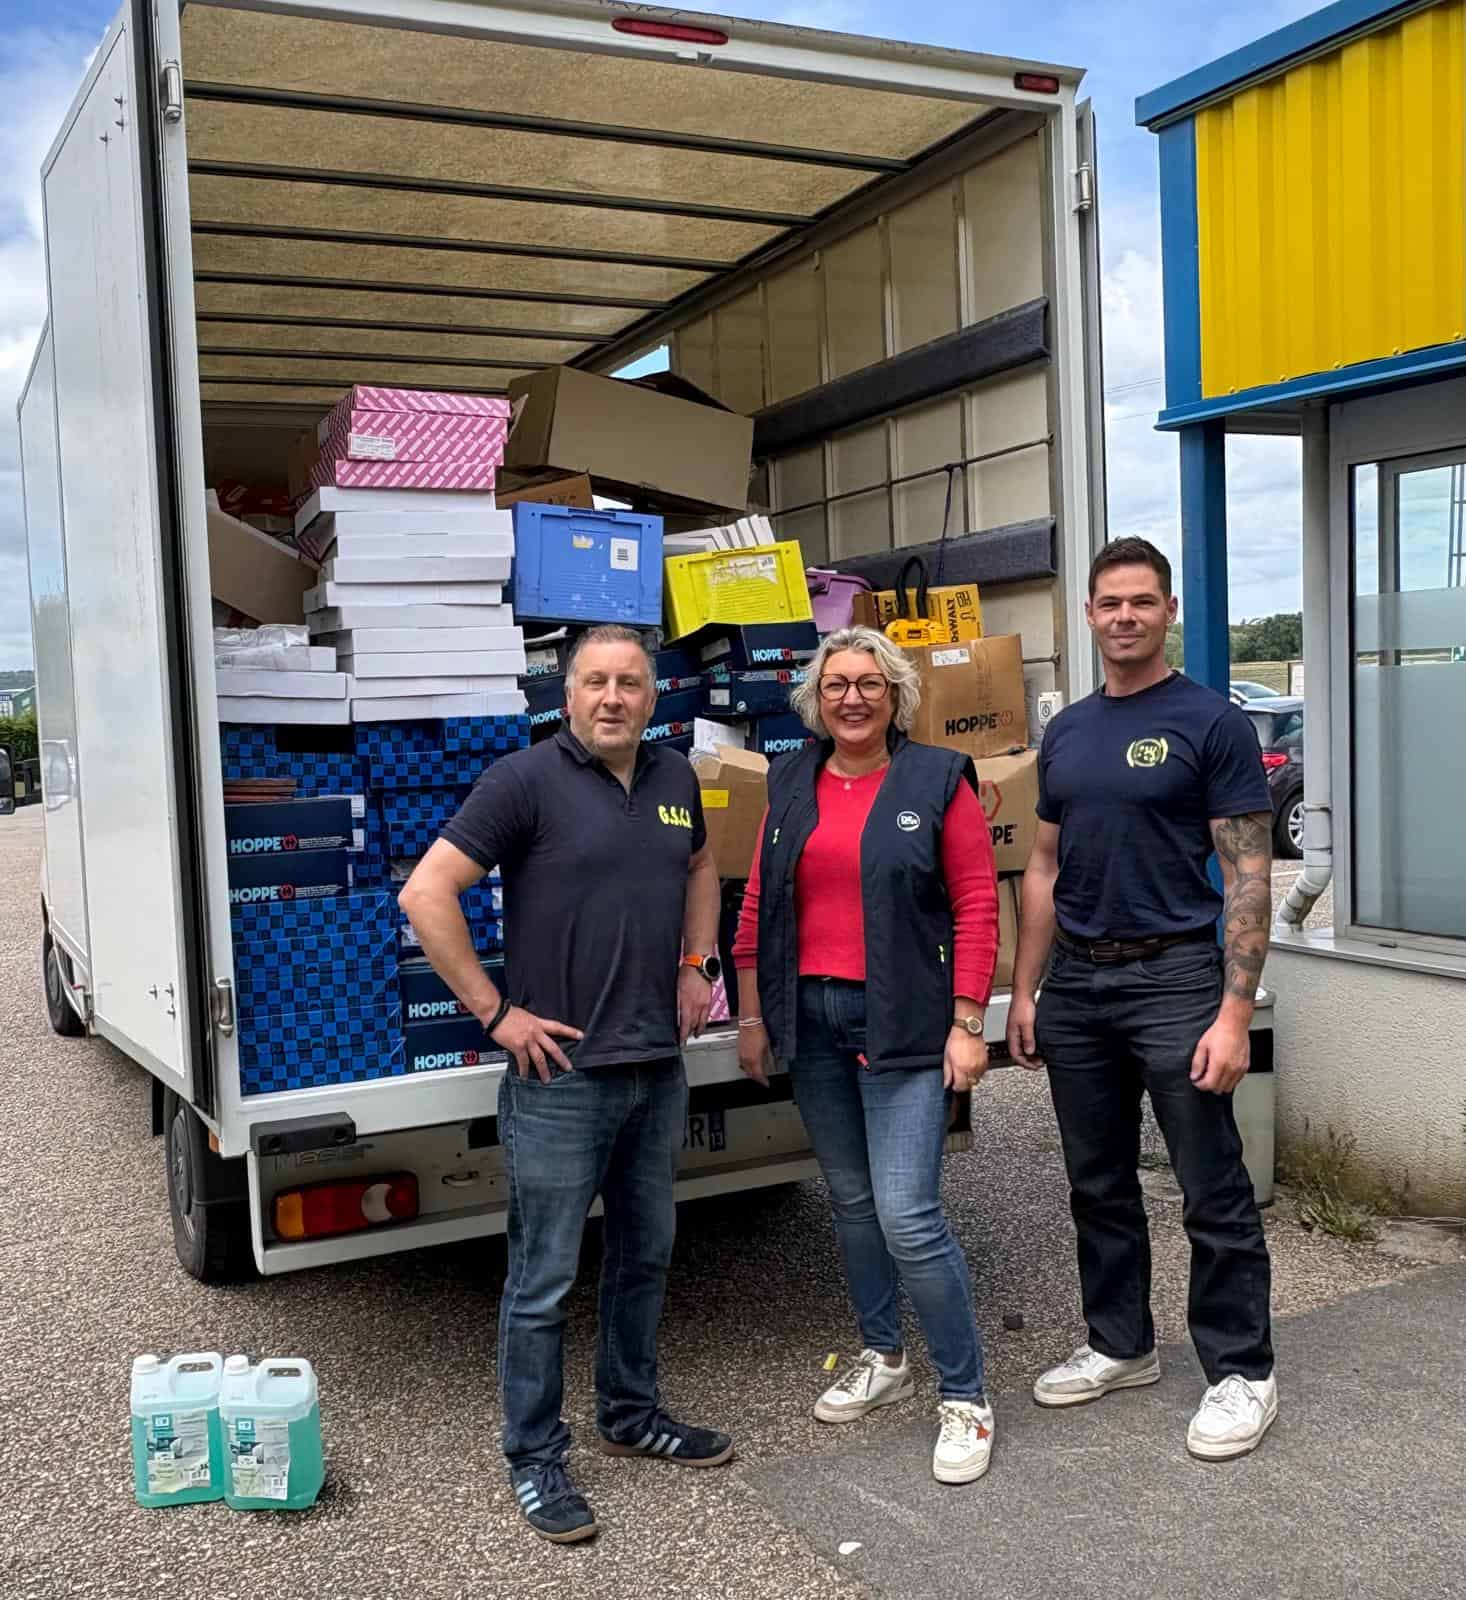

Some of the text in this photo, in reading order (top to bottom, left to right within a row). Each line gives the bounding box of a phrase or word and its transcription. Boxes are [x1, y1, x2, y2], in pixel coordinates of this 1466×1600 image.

[752, 648, 784, 661] HOPPE
[526, 664, 550, 676] OPPE
[655, 678, 672, 692] PPE
[529, 708, 563, 725] HOPPE
[945, 712, 1000, 736] HOPPE
[642, 723, 673, 741] OPPE
[230, 836, 282, 853] HOPPE
[229, 885, 280, 903] HOPPE
[408, 1001, 457, 1018] HOPPE
[414, 1051, 464, 1070] HOPPE
